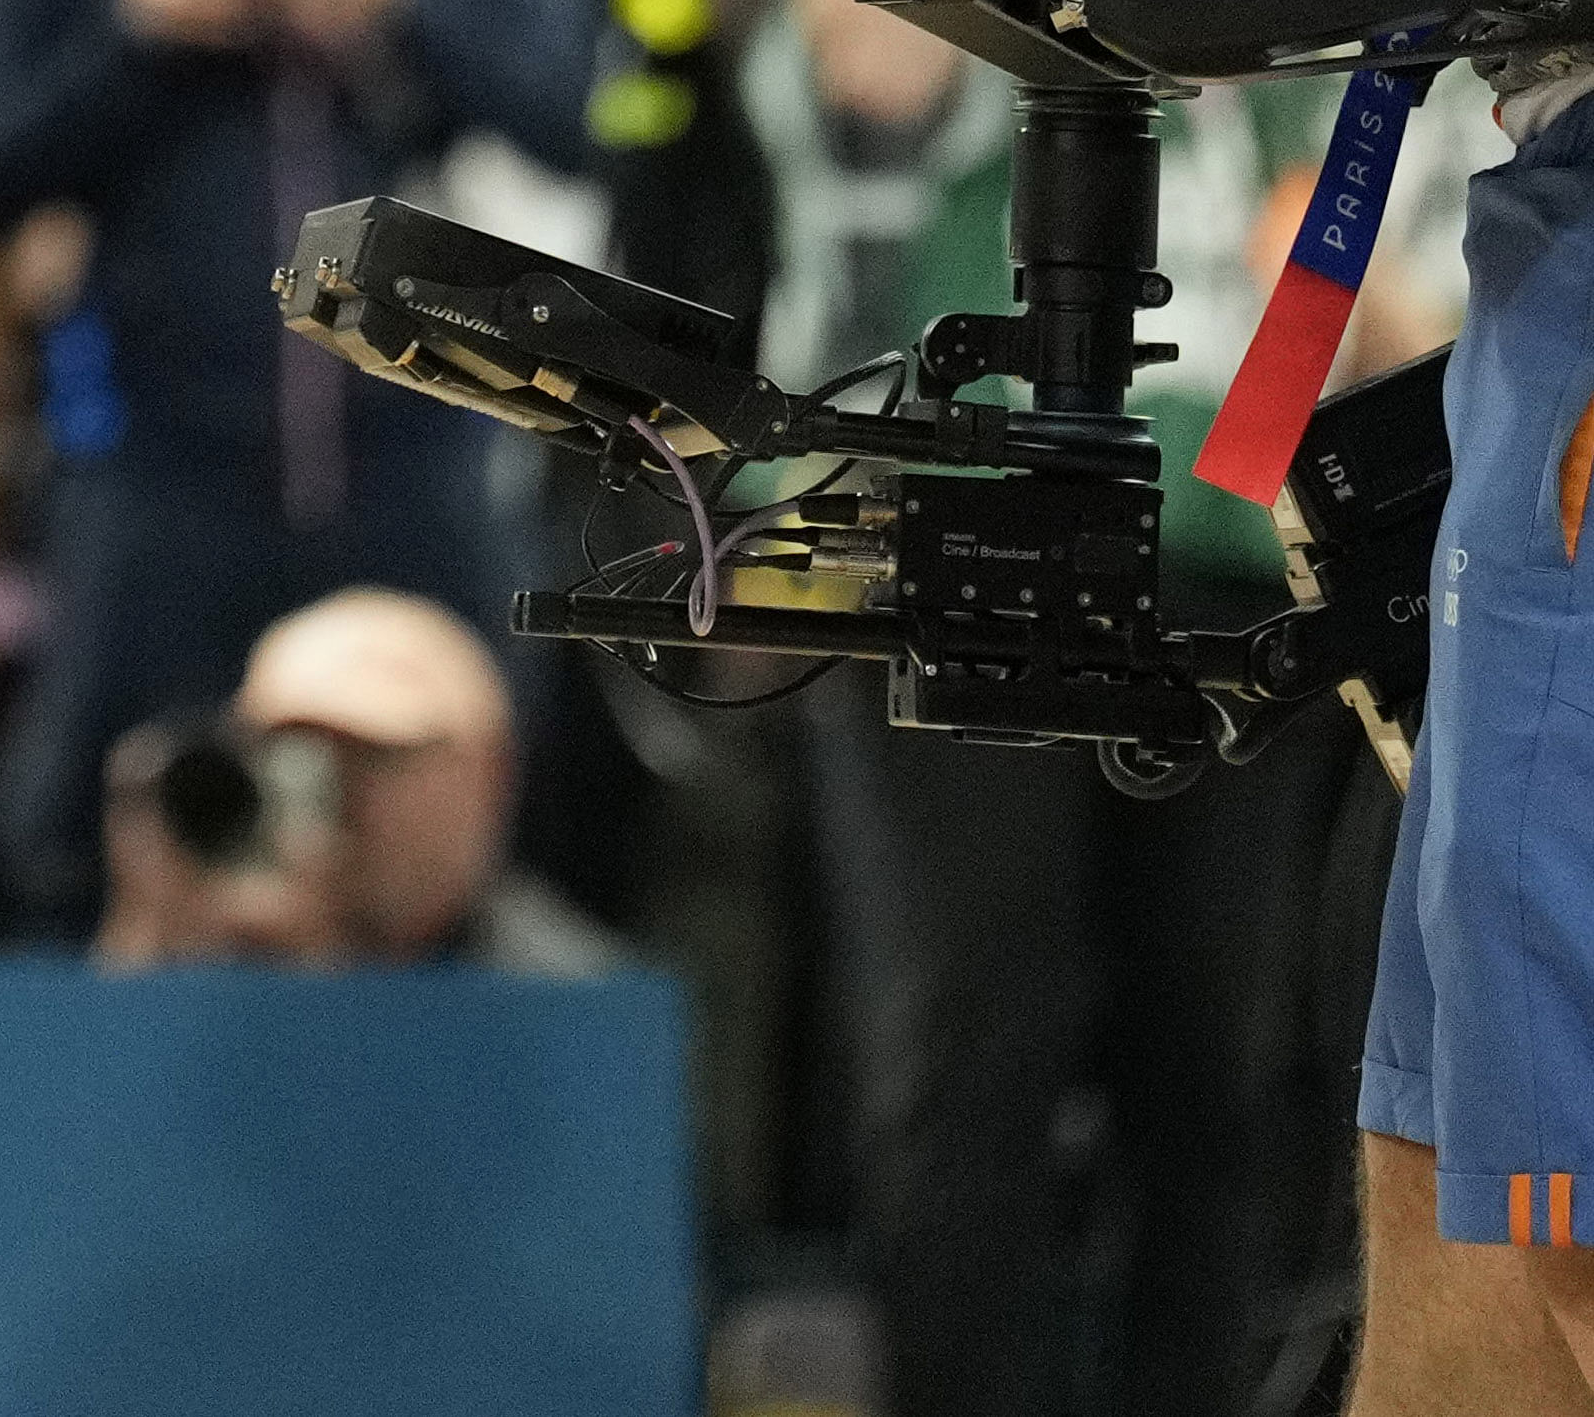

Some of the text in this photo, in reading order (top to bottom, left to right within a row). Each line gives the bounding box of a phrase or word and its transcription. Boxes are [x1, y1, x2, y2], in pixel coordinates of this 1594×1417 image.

[1323, 110, 1383, 252] PARIS
[942, 543, 1041, 560] Cine / Broadcast
[1387, 595, 1430, 622] Cin
